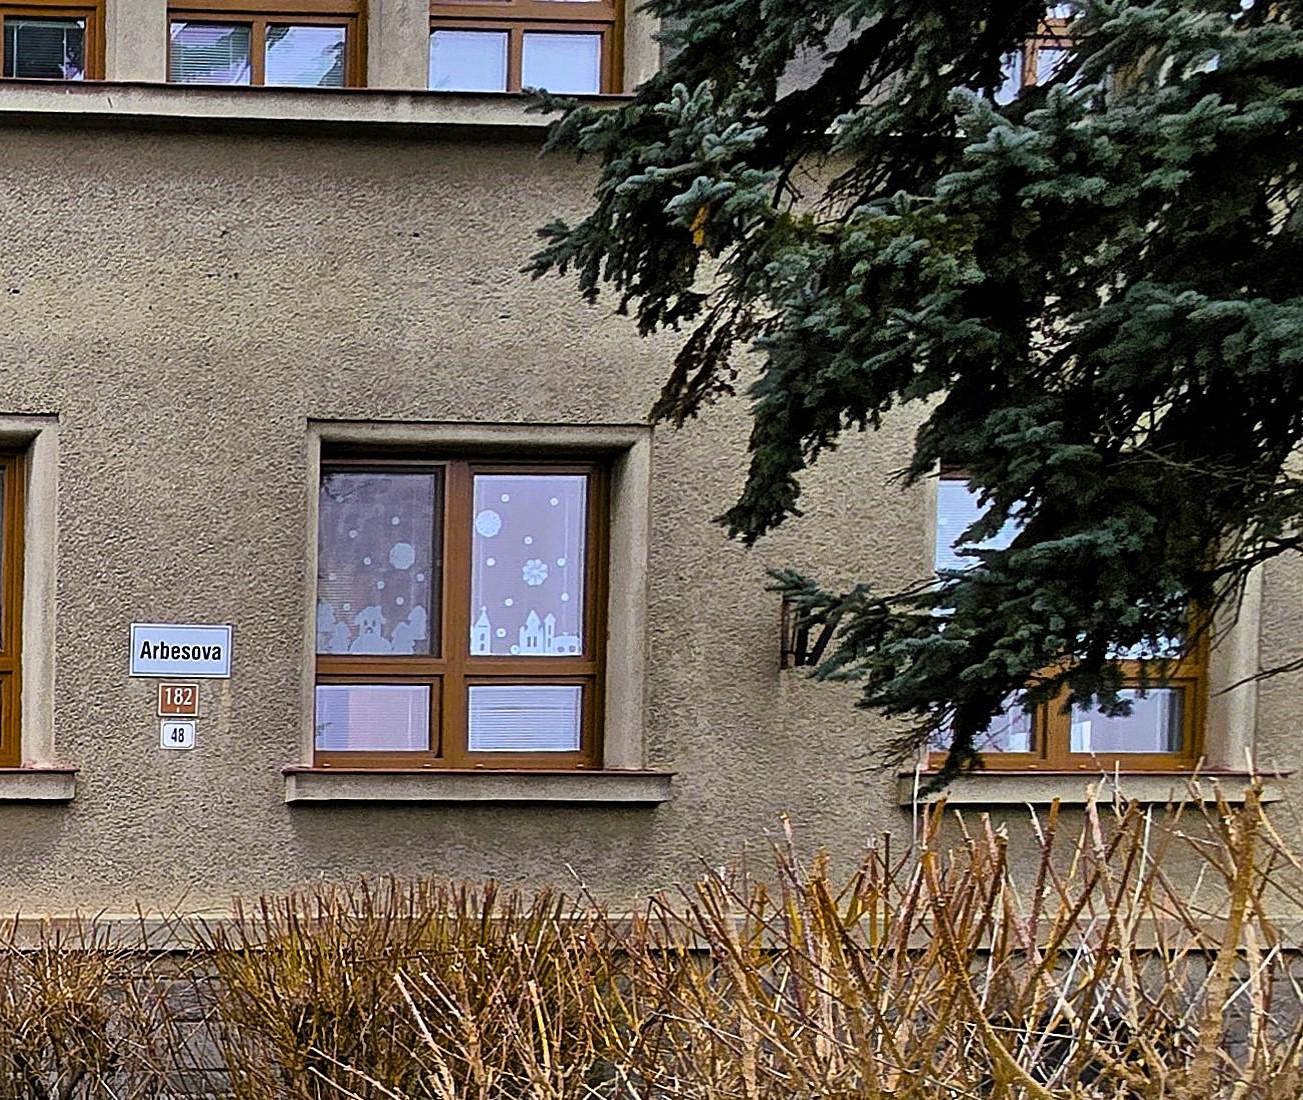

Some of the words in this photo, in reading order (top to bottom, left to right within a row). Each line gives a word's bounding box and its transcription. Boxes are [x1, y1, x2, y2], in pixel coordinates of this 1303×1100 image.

[140, 641, 221, 660] Arbesova
[165, 688, 192, 705] 182
[171, 728, 185, 743] 48
